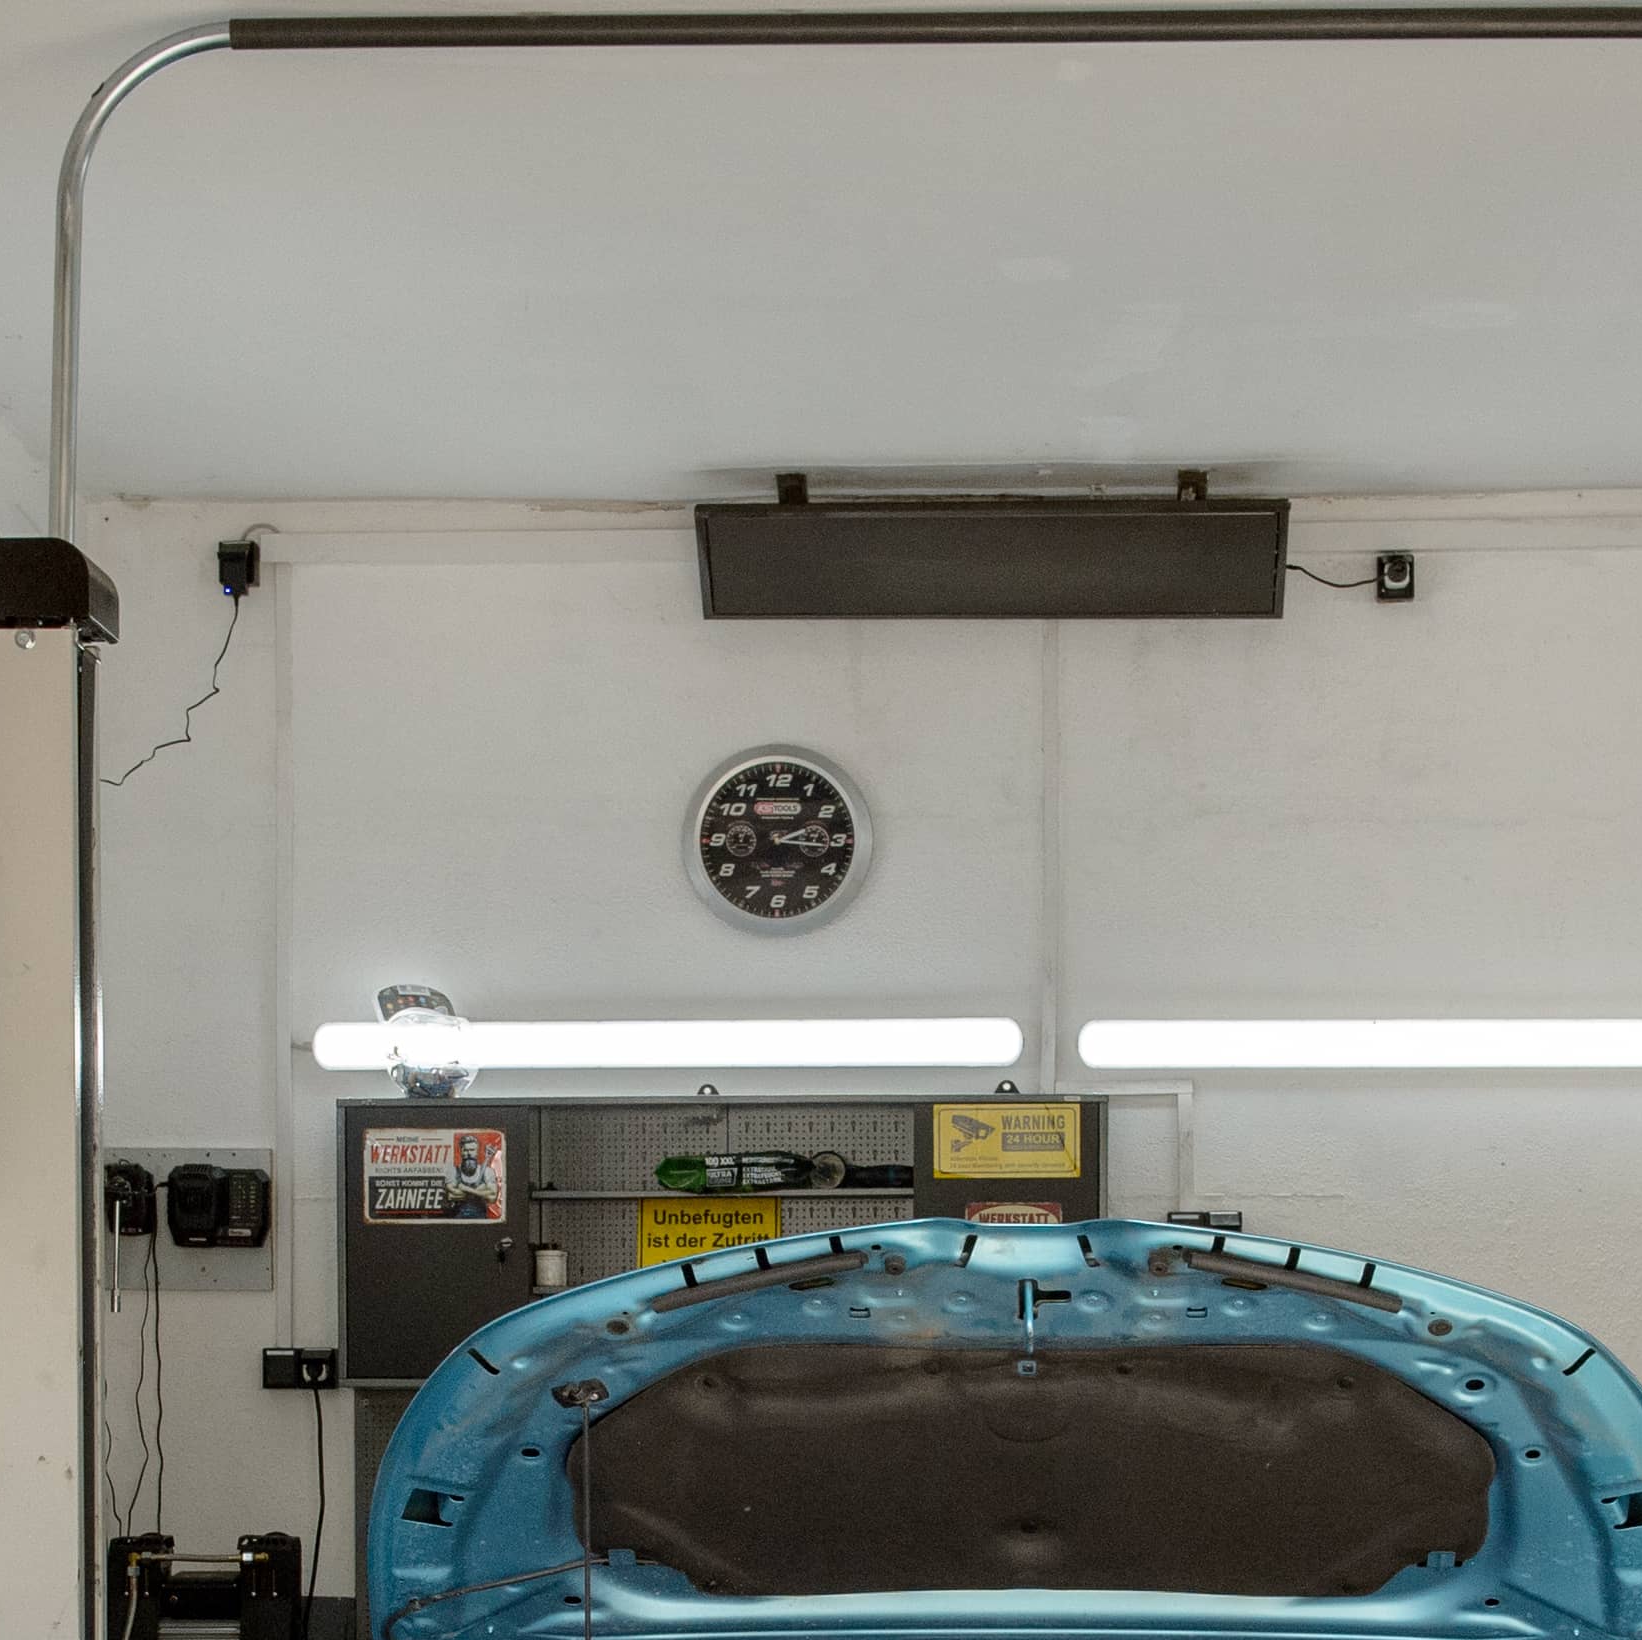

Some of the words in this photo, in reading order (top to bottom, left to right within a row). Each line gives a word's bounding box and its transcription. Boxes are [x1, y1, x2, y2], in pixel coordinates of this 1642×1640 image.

[766, 774, 793, 788] 12
[736, 783, 758, 797] 11
[803, 783, 814, 797] 1
[719, 802, 747, 816] 10
[817, 805, 836, 818] 2
[709, 833, 726, 846] 9
[830, 833, 846, 847] 3
[719, 863, 735, 877] 8
[820, 862, 837, 876] 4
[745, 885, 761, 898] 7
[802, 885, 820, 899] 5
[770, 895, 787, 908] 6
[1001, 1115, 1065, 1130] WARNING
[1006, 1134, 1021, 1145] 24
[1024, 1134, 1059, 1144] HOUR
[370, 1145, 452, 1164] WERKSTATT
[375, 1189, 445, 1209] ZAHNFEE
[653, 1210, 764, 1228] Unbefugten
[647, 1233, 670, 1248] ist
[676, 1233, 707, 1248] der
